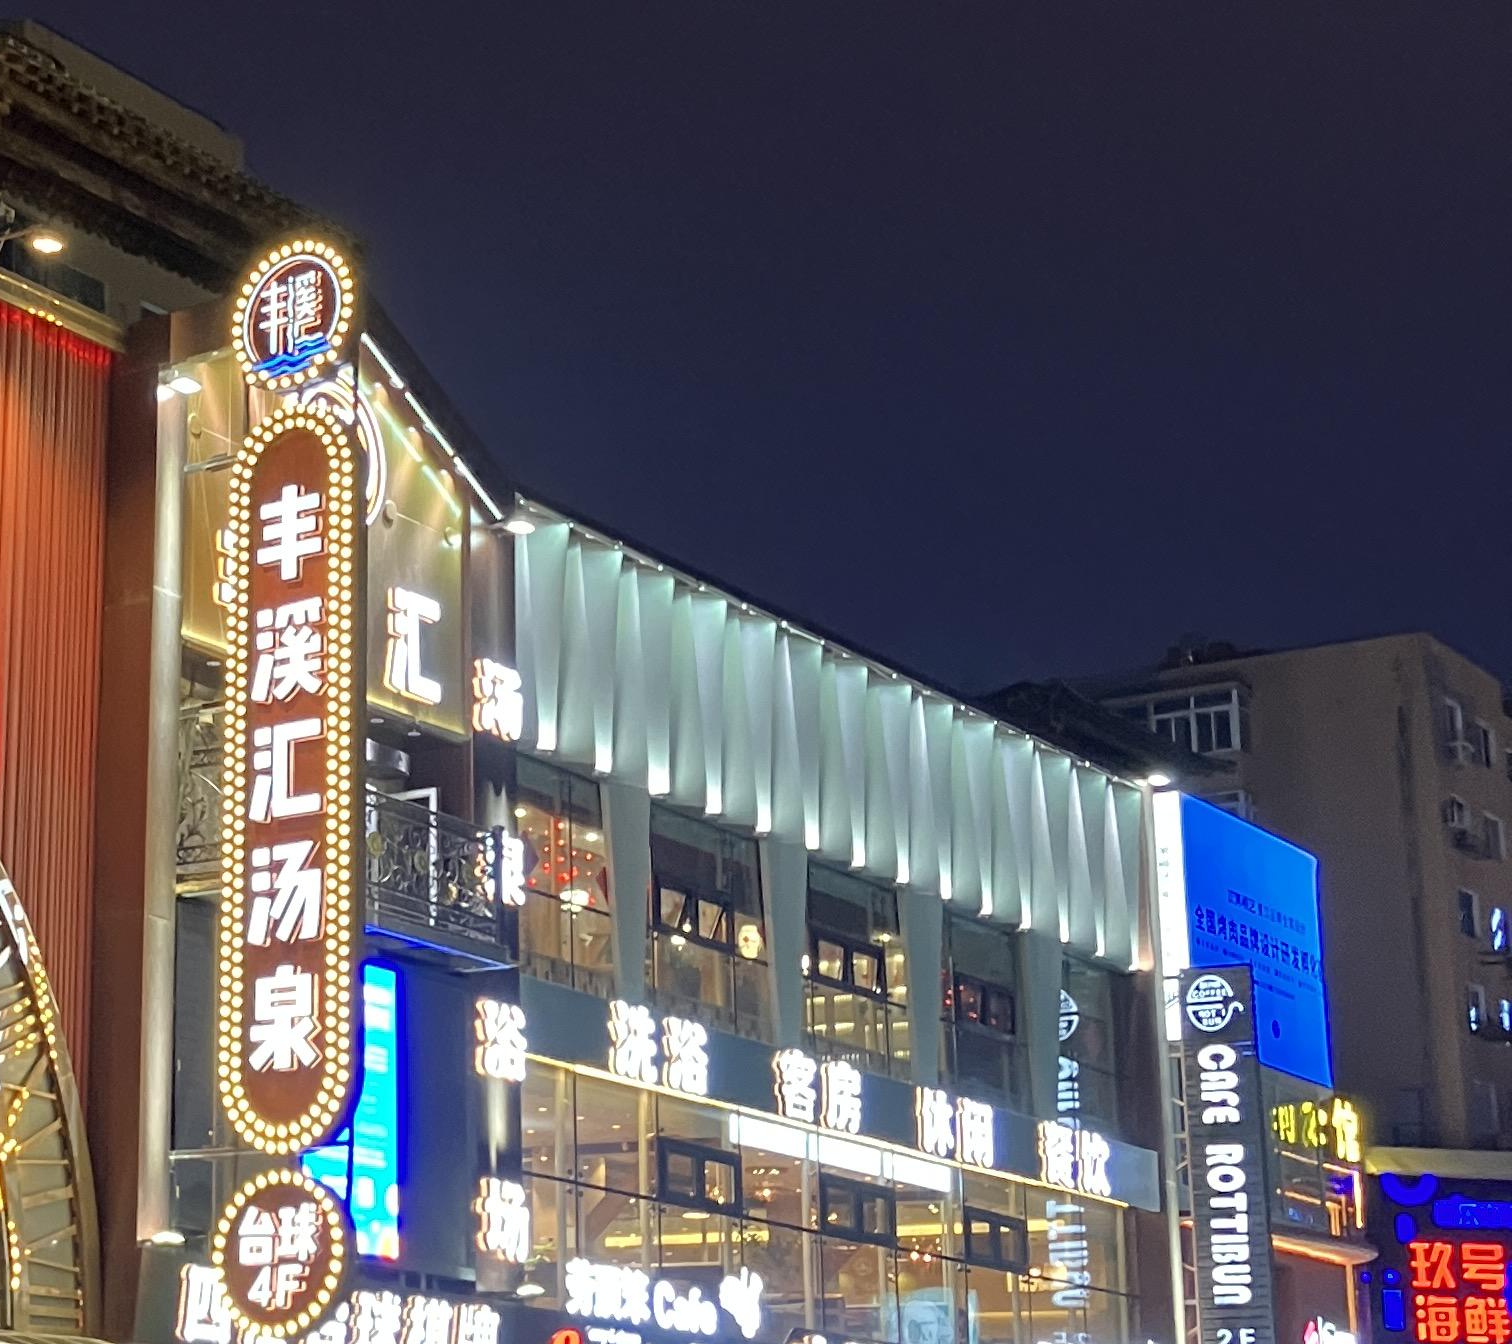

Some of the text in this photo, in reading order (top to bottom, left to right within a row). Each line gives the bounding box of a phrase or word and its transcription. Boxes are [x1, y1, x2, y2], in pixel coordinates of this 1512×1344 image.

[248, 484, 329, 1074] 丰溪汇汤泉
[607, 1000, 710, 1096] 洗浴
[1197, 1044, 1241, 1124] CAFE
[771, 1048, 863, 1135] 客房
[238, 1202, 321, 1266] 台球
[1205, 1143, 1253, 1305] ROTTIBUN
[247, 1262, 310, 1311] 4F
[1409, 1240, 1506, 1291] 玖号
[1414, 1294, 1511, 1344] 海鲜
